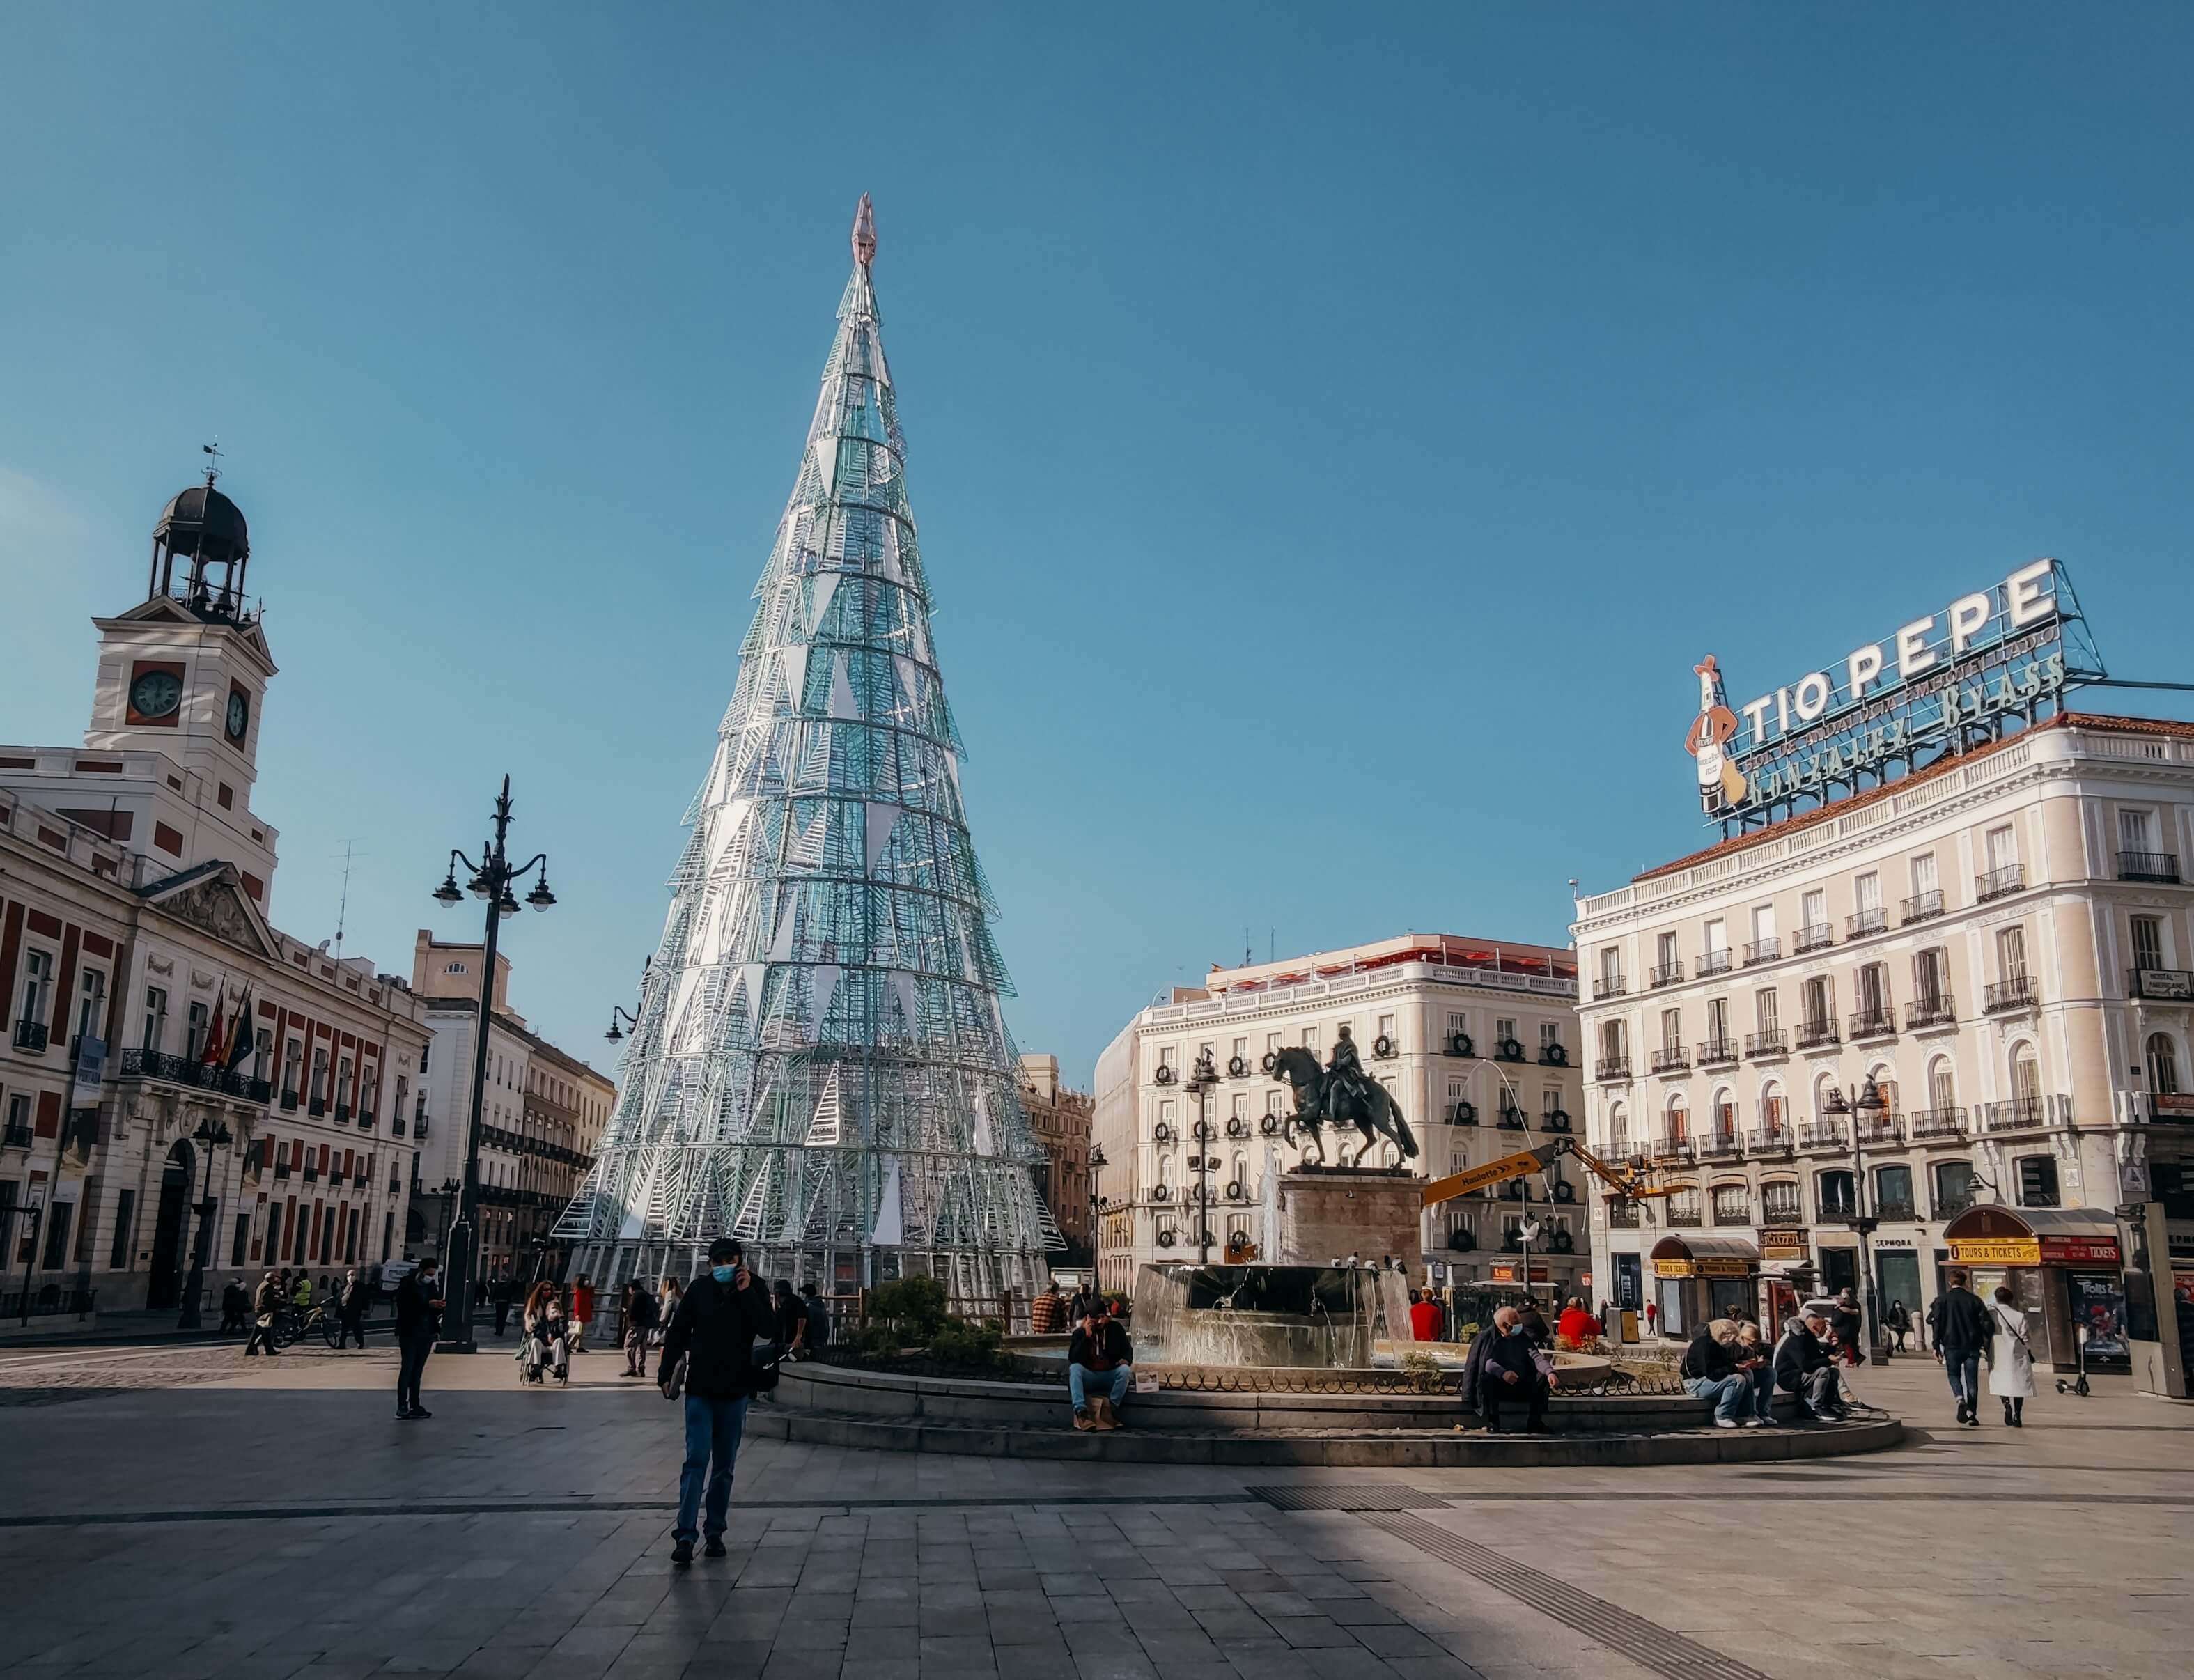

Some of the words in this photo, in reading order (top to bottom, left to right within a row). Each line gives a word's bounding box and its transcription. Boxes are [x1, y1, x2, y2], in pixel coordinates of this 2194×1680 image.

[1743, 671, 1828, 744] TIO
[1849, 557, 2055, 699] PEPE
[1749, 717, 1907, 807] GONZALEZ
[1941, 652, 2064, 729] BYASS
[1745, 751, 1773, 770] SOL
[1780, 739, 1798, 757] DE
[1461, 1168, 1498, 1187] Haulotte
[1961, 1247, 1982, 1259] TOURS
[1984, 1247, 1990, 1259] &
[1992, 1247, 2021, 1259] TICKETS
[2089, 1246, 2116, 1259] TICKETS
